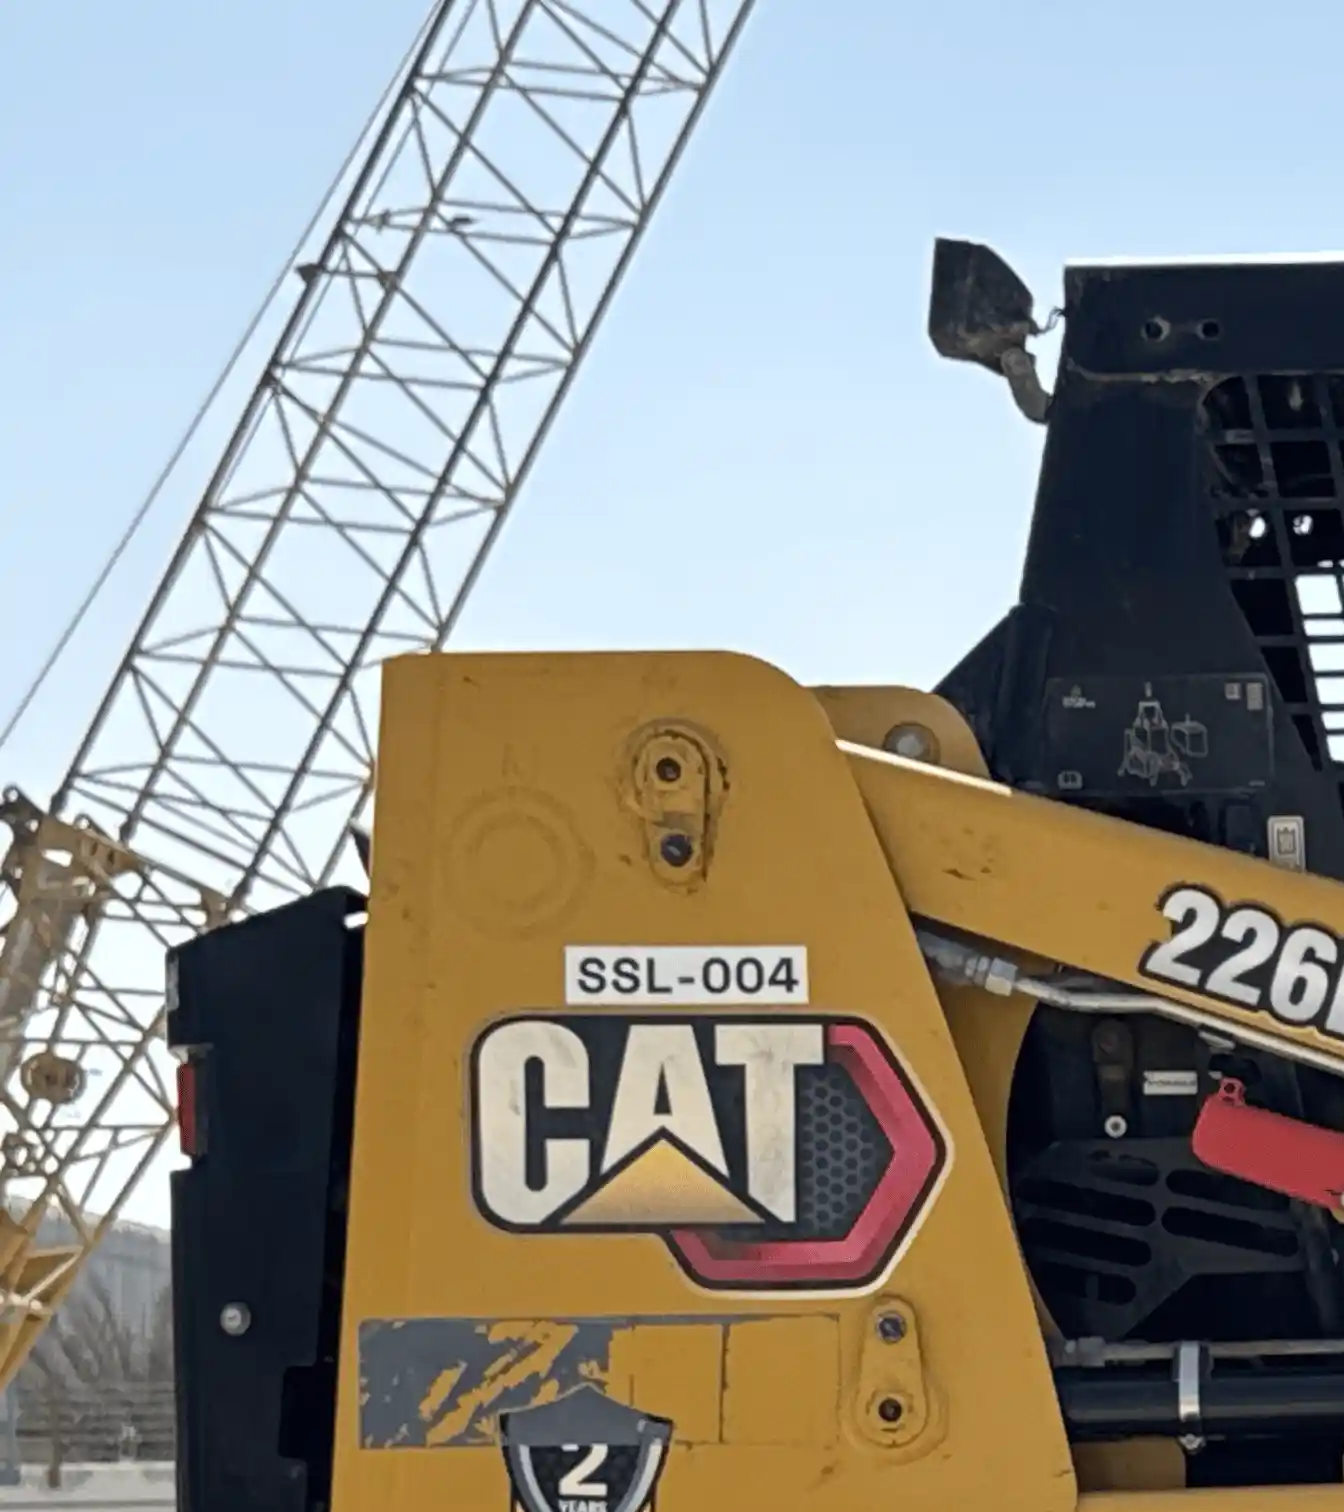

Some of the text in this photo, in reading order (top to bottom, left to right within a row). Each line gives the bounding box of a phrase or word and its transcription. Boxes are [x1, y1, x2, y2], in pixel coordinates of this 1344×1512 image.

[577, 956, 800, 995] SSL-004
[477, 1019, 825, 1225] CAT
[558, 1443, 608, 1497] 2
